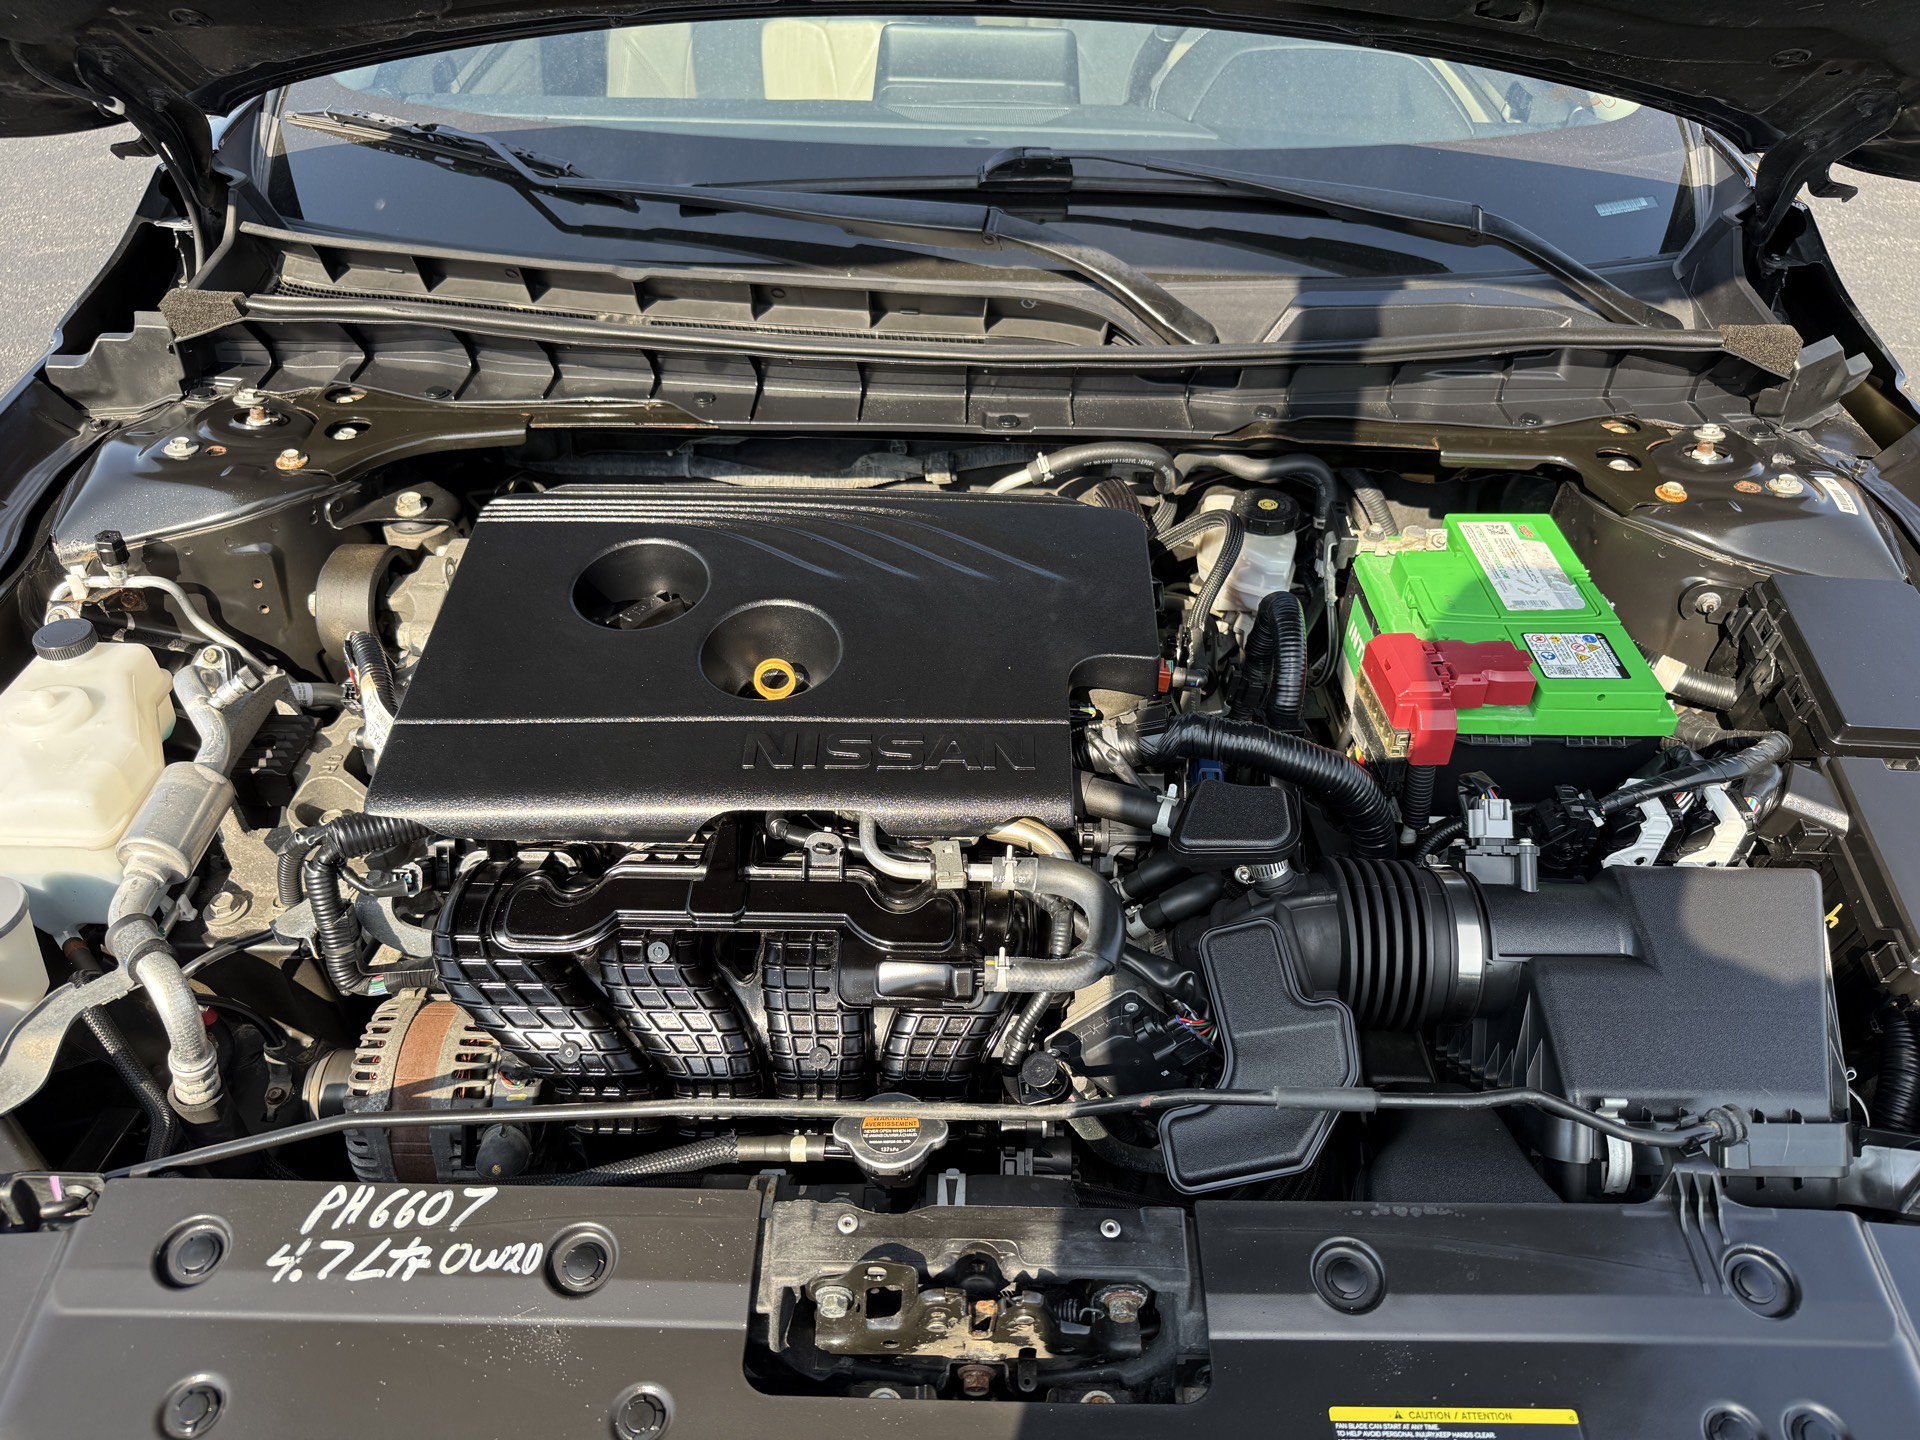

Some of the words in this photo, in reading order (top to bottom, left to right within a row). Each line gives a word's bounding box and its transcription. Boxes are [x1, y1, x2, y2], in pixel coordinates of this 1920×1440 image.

[741, 732, 1037, 771] NISSAN
[299, 1184, 498, 1235] PH6607
[1408, 1411, 1450, 1420] CAUTION
[1462, 1411, 1512, 1420] ATTENTION
[1337, 1430, 1346, 1438] TO
[1346, 1430, 1362, 1438] HELP
[1363, 1430, 1382, 1438] AVOID
[1382, 1430, 1415, 1438] PERSONAL
